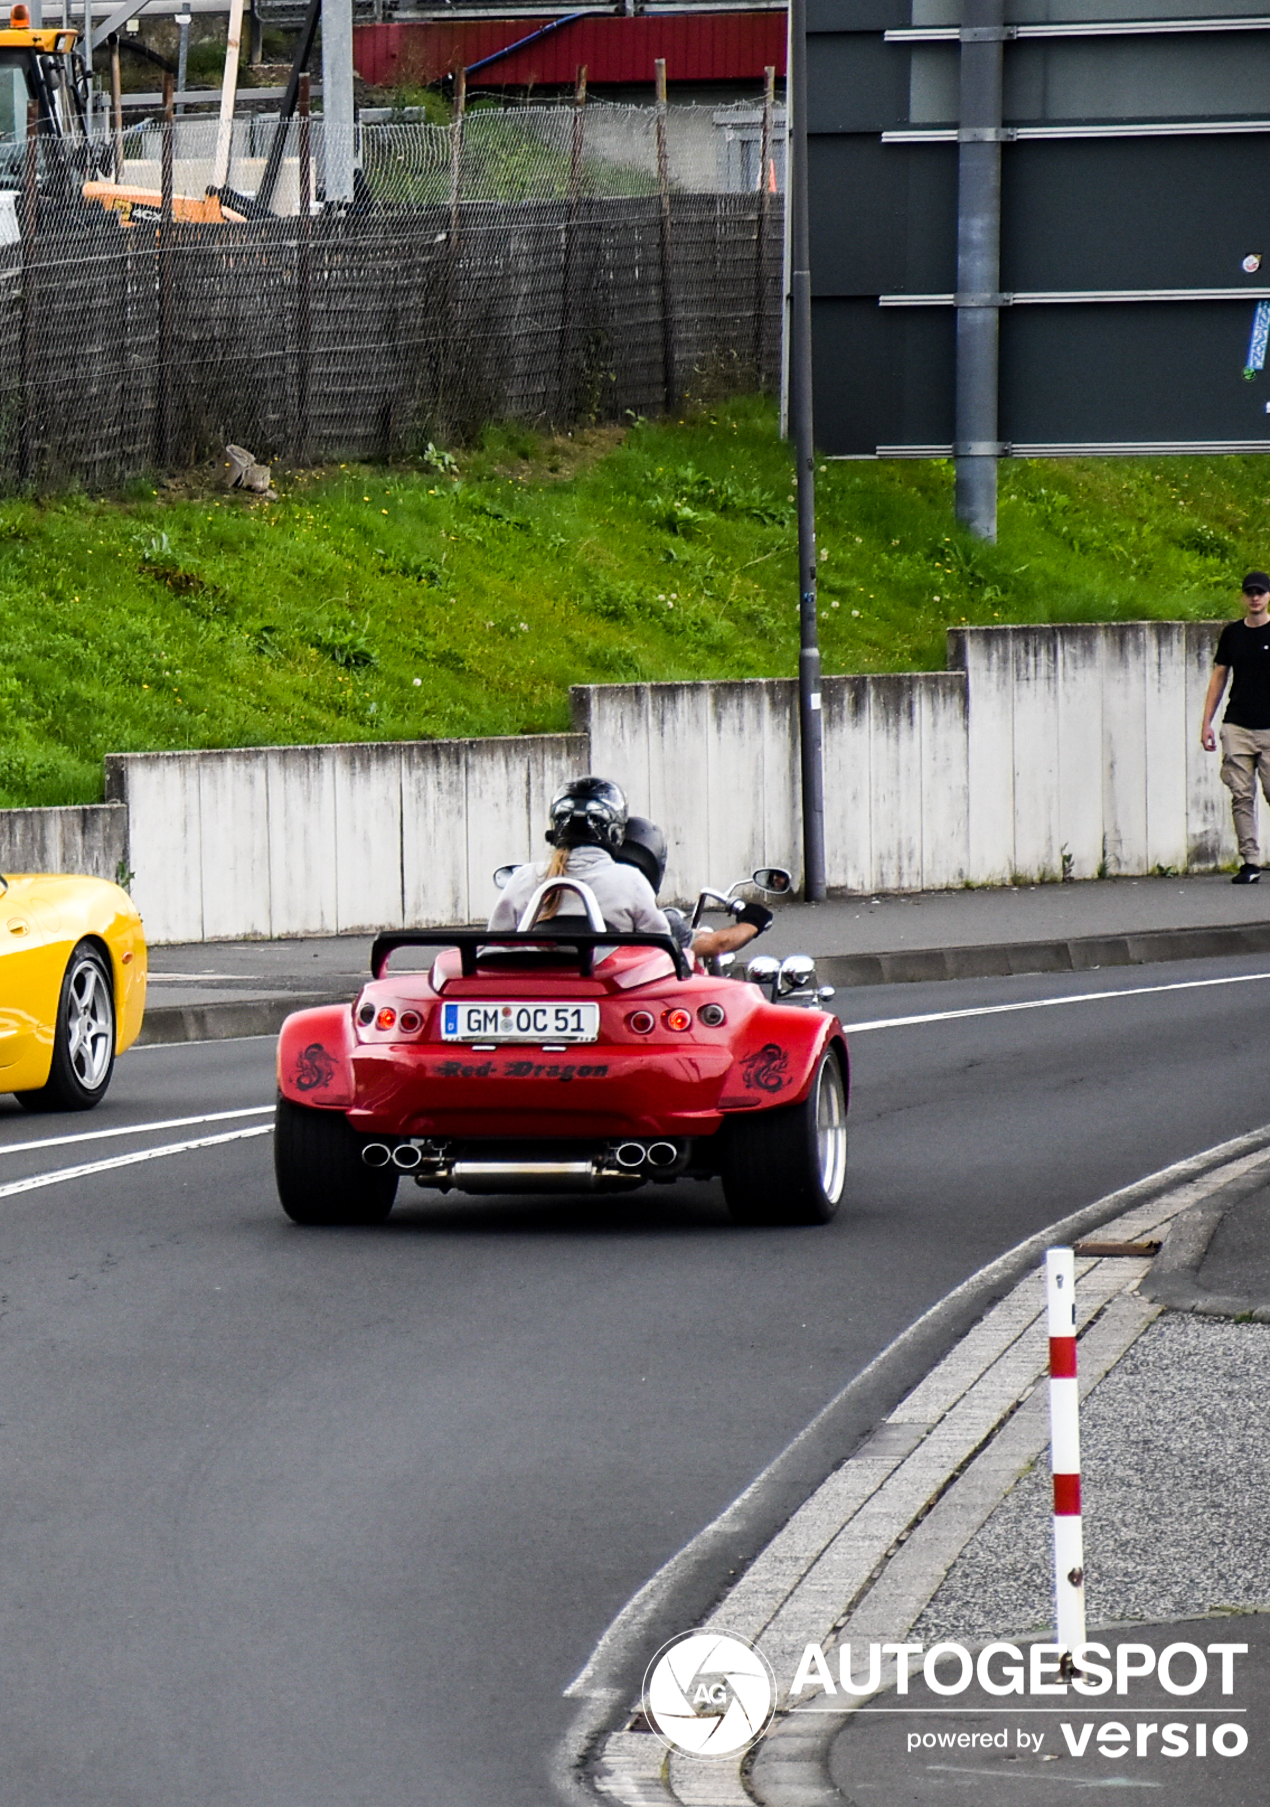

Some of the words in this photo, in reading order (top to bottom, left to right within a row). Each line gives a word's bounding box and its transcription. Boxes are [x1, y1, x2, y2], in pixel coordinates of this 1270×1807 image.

[466, 1008, 499, 1033] GM
[516, 1008, 548, 1033] OC
[554, 1008, 585, 1033] 51
[505, 1061, 609, 1082] Dragon
